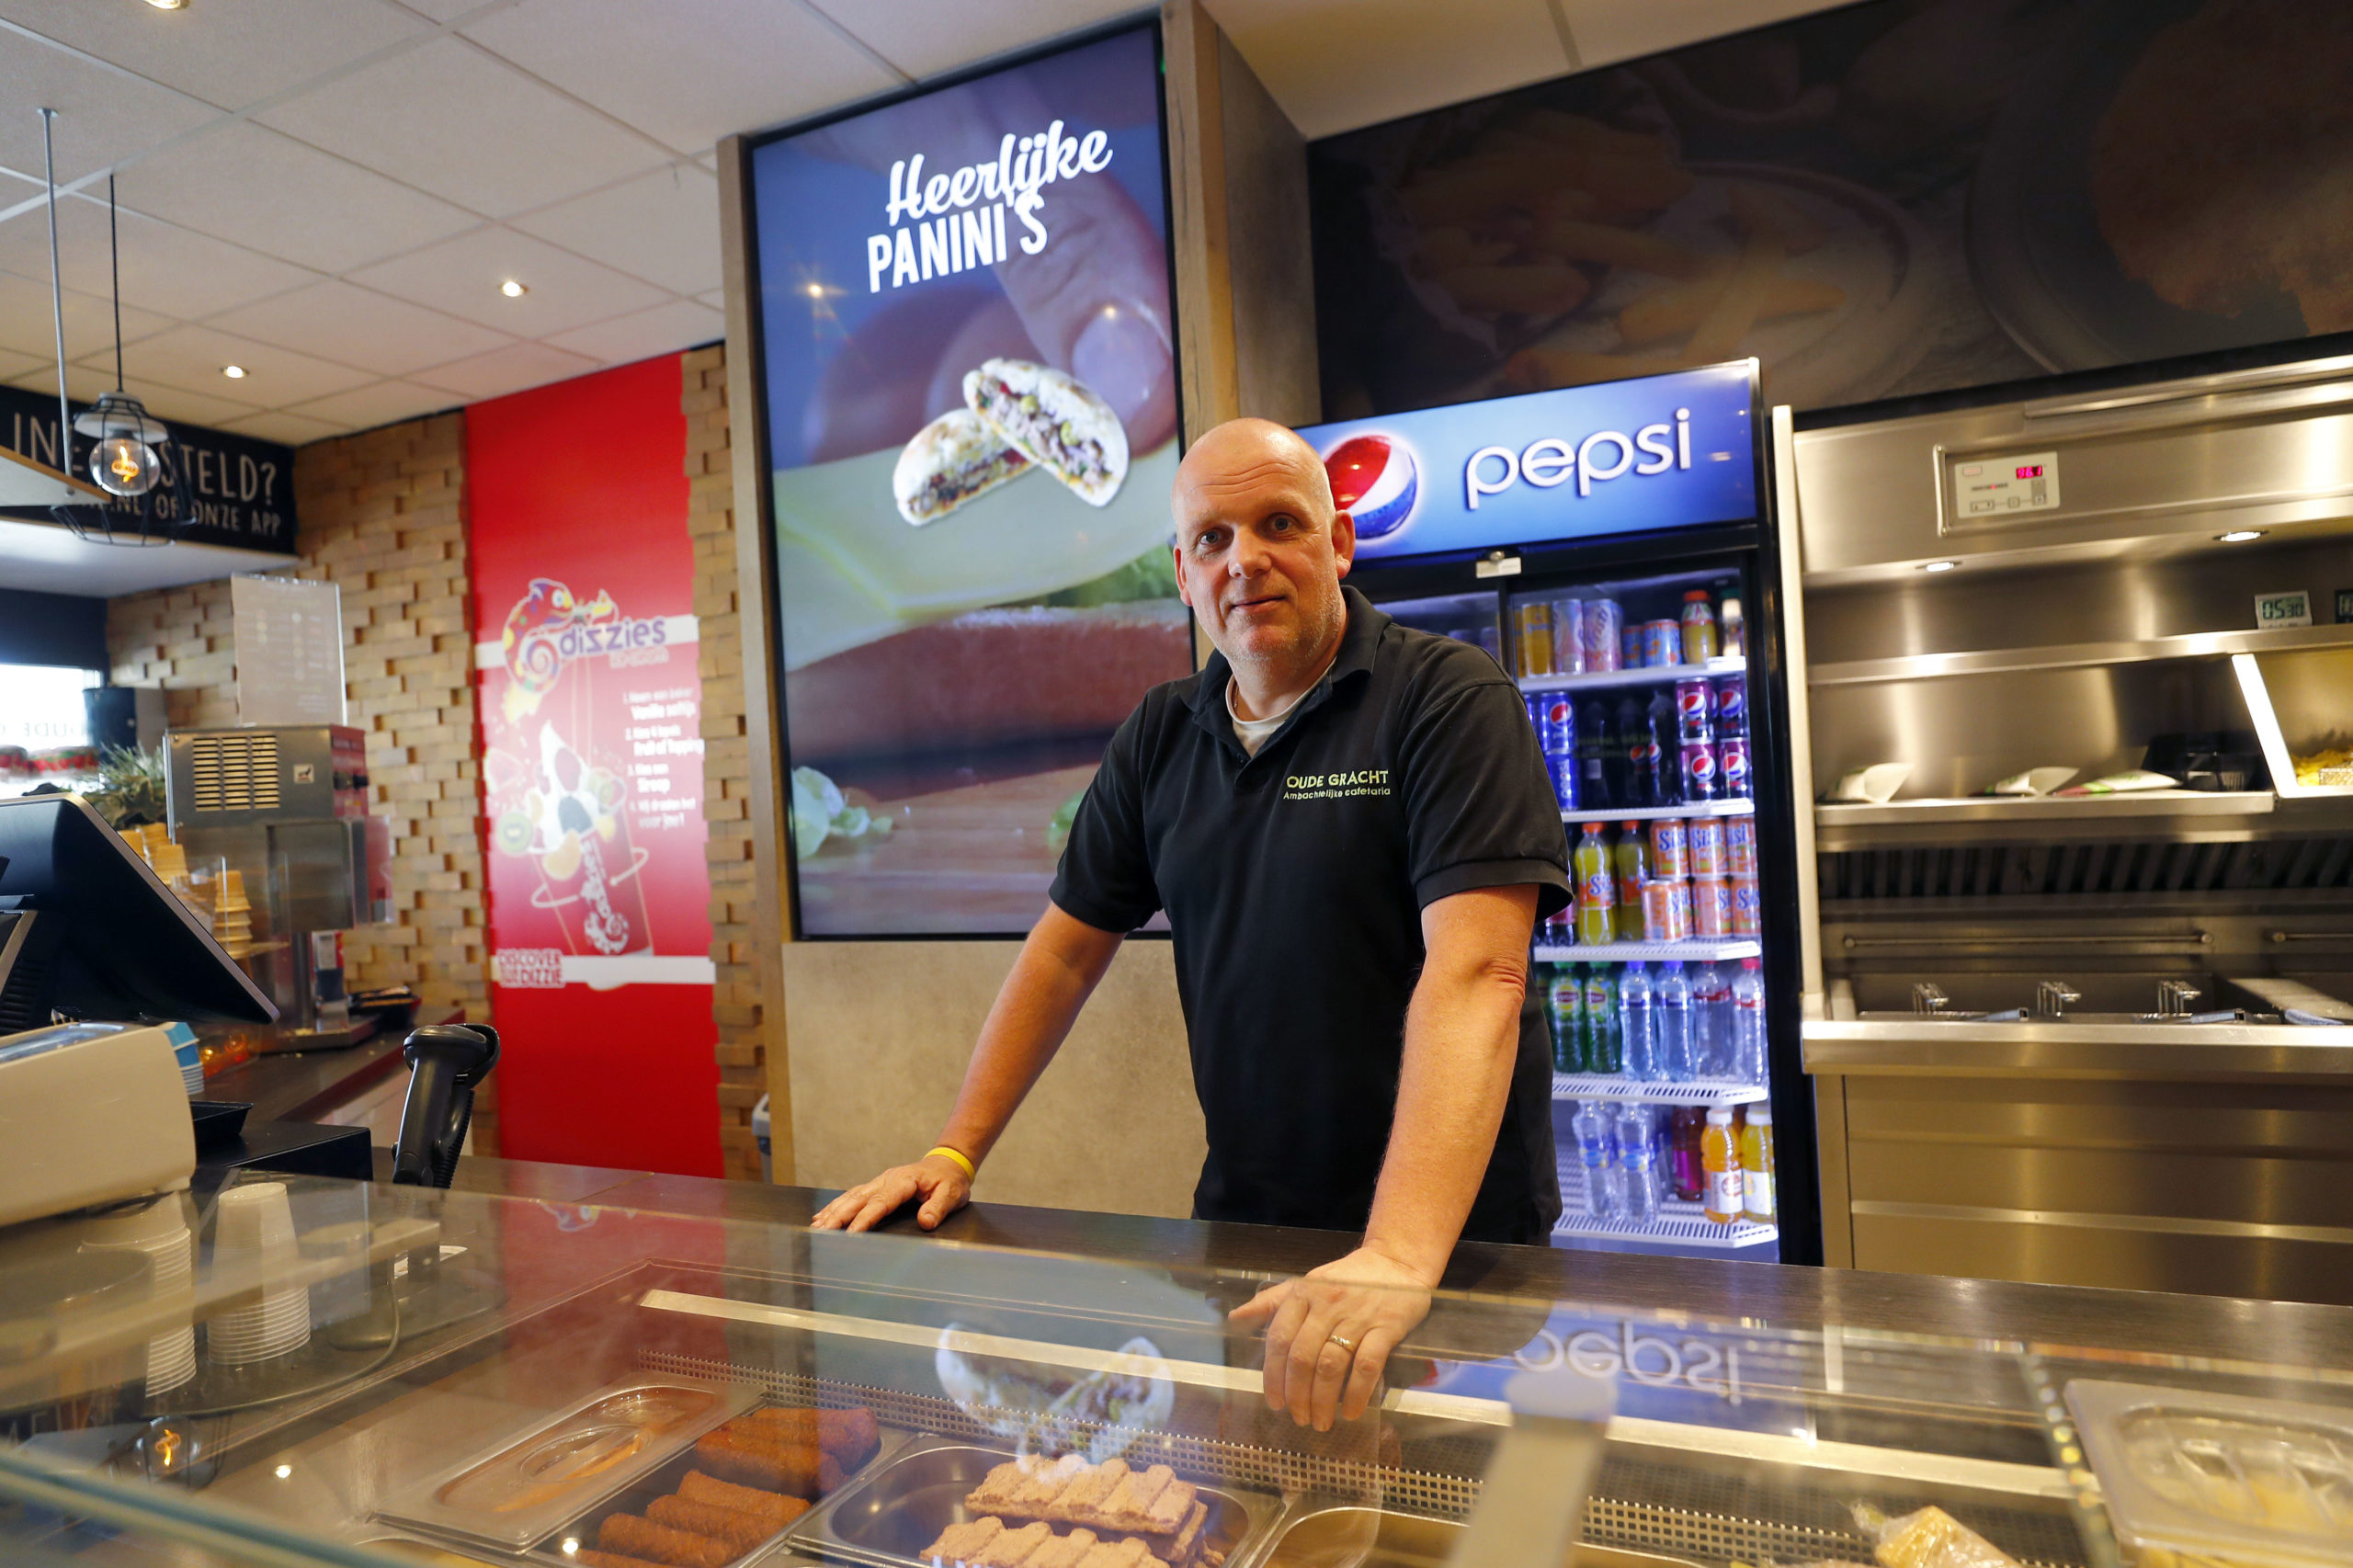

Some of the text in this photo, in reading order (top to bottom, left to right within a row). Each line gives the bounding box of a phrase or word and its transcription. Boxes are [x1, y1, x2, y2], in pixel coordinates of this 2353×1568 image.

[885, 119, 1113, 227] Heerlijke
[158, 440, 277, 506] STELD?
[1465, 407, 1691, 510] pepsi
[251, 509, 281, 538] APP
[559, 619, 666, 657] dizzies
[1283, 786, 1391, 801] Ambachtelijke cafetaria
[1286, 769, 1389, 790] OUDE GRACHT
